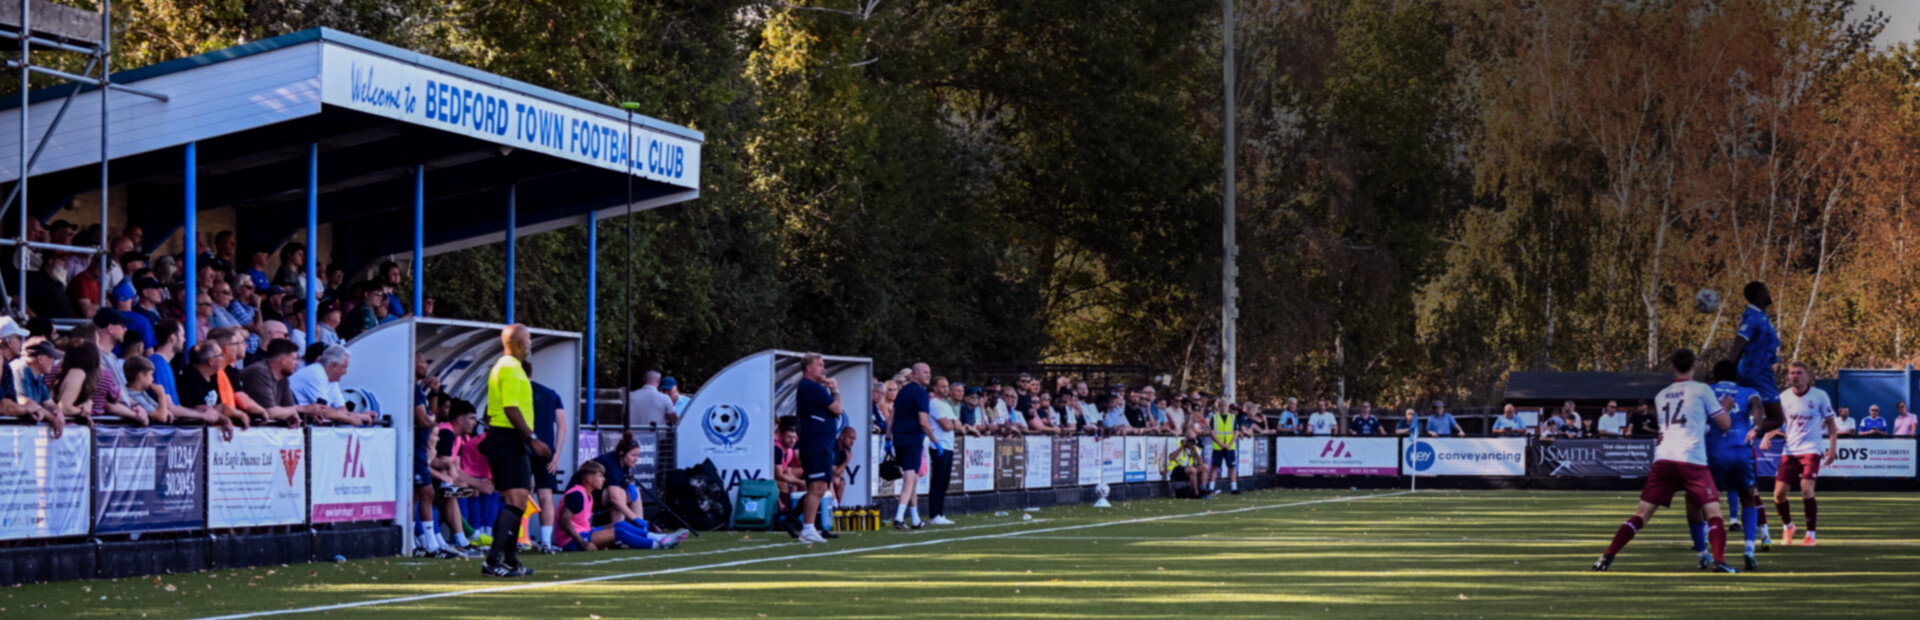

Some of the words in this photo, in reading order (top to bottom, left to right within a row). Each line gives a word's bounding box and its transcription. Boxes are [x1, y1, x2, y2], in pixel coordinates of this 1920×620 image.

[351, 60, 401, 109] Welcome
[405, 82, 416, 114] to
[425, 79, 509, 136] BEDFORD
[516, 103, 564, 150] TOWN
[571, 118, 643, 170] FOOTBALL
[649, 139, 684, 179] CLUB
[1662, 399, 1688, 428] 14
[168, 446, 193, 469] 01234
[1438, 451, 1521, 463] conveyancing
[164, 472, 195, 496] 302043
